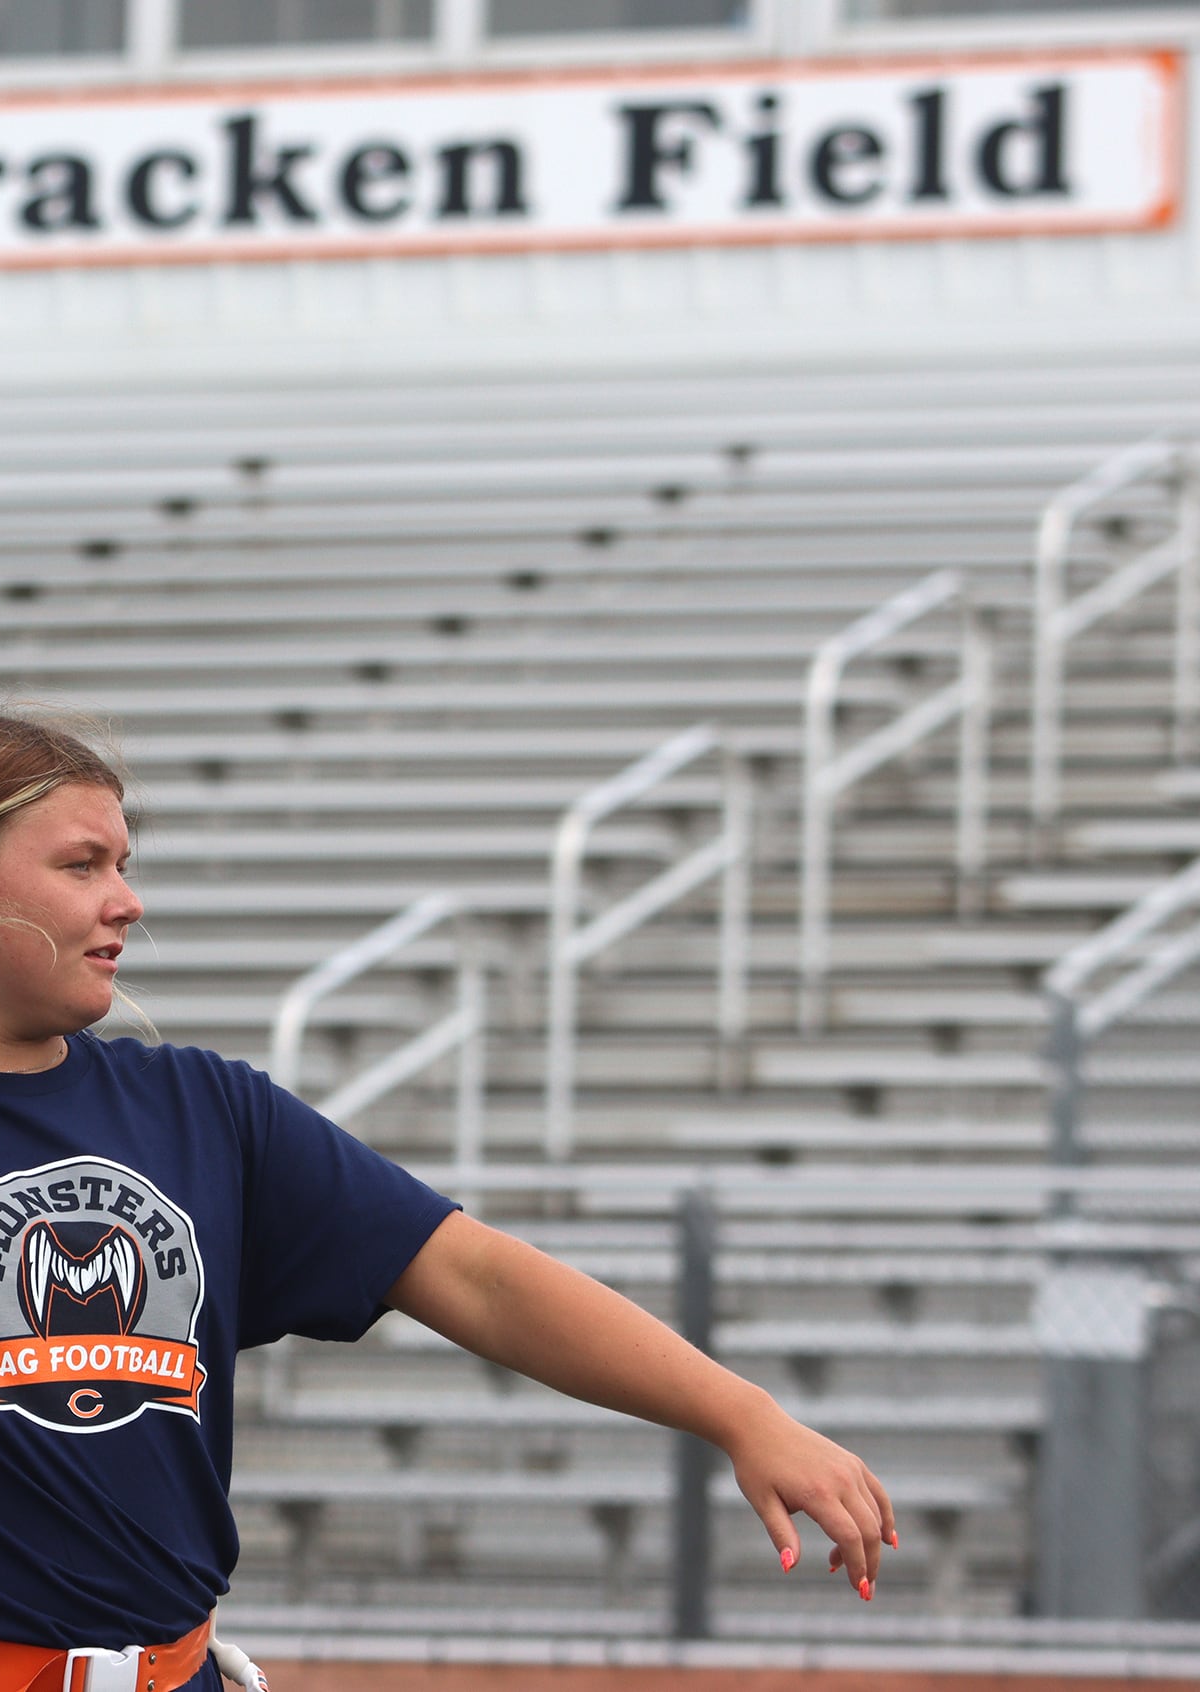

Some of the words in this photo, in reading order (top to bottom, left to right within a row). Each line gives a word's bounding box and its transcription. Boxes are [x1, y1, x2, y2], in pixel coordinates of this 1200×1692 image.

[614, 82, 1073, 214] Field
[50, 1345, 185, 1379] FOOTBALL
[67, 1389, 104, 1418] C
